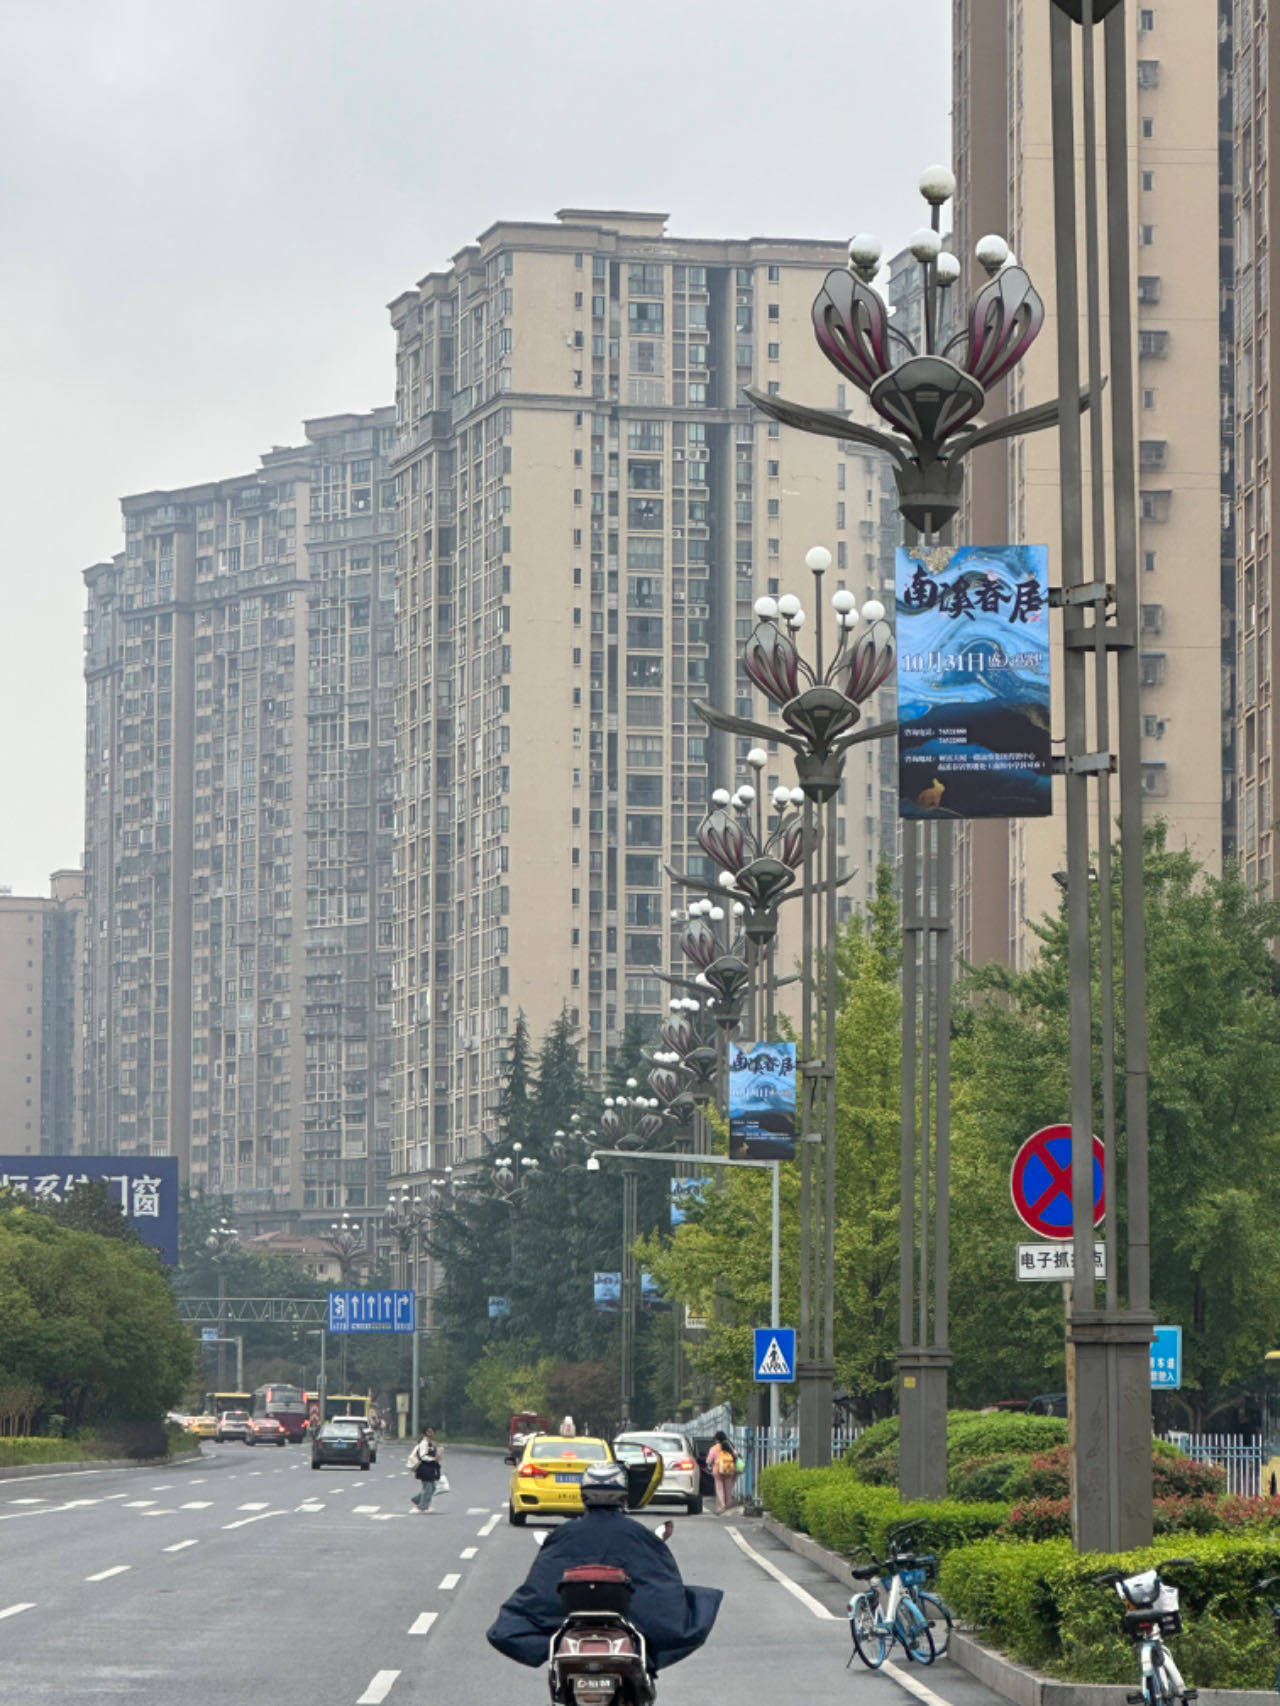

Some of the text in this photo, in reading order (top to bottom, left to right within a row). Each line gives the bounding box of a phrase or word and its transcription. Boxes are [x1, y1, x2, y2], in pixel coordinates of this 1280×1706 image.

[902, 652, 984, 673] 10月31日
[1021, 1251, 1102, 1269] 电子抓点
